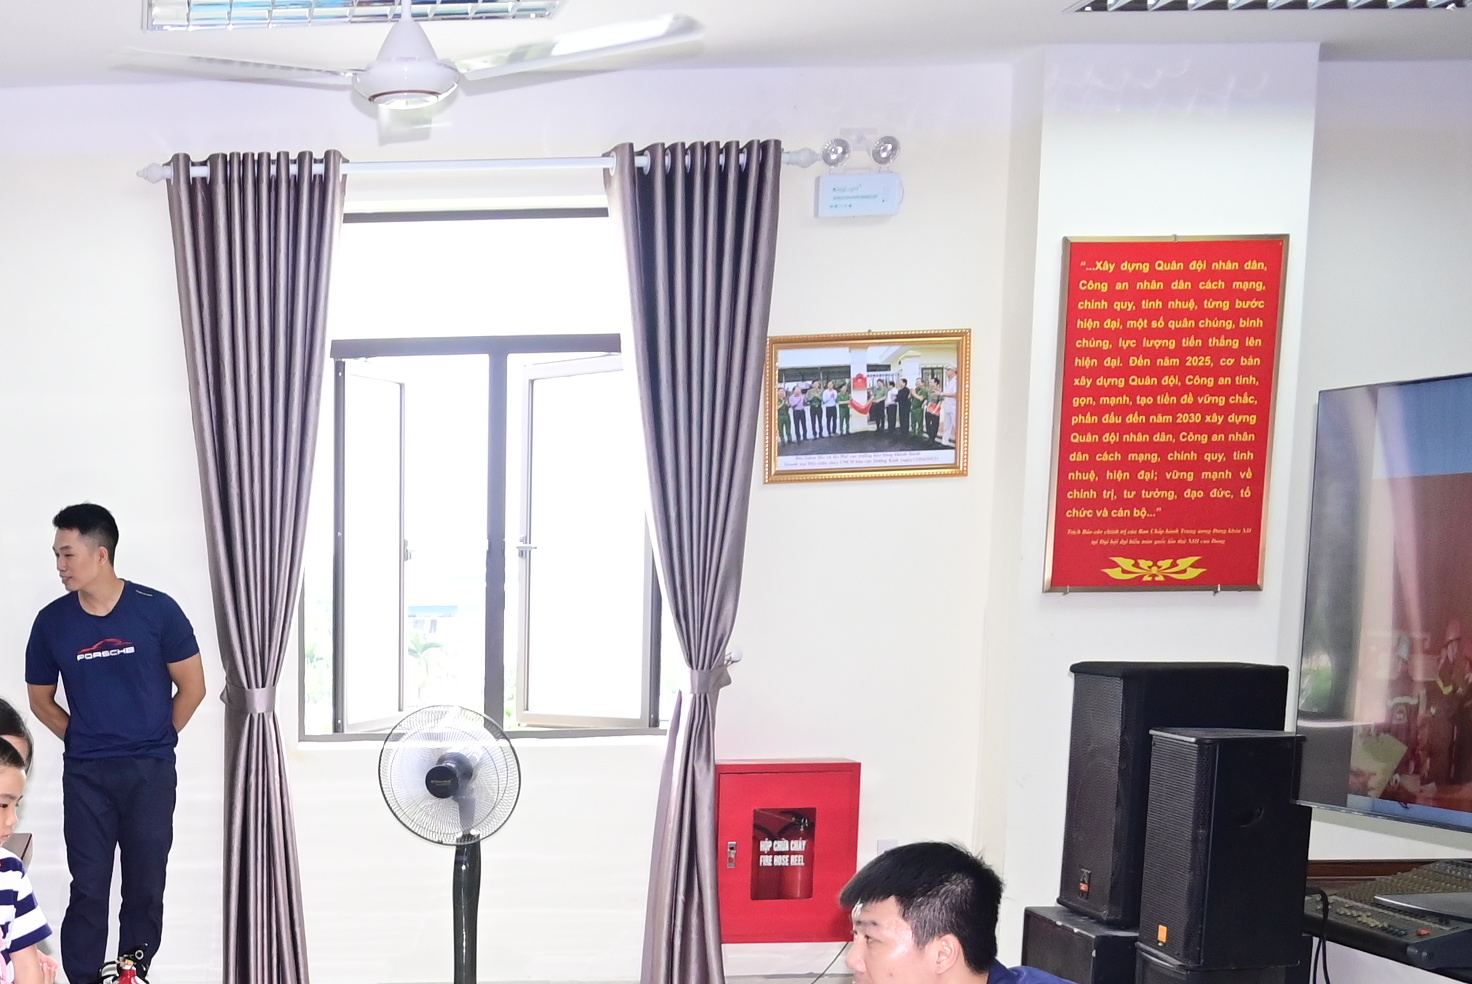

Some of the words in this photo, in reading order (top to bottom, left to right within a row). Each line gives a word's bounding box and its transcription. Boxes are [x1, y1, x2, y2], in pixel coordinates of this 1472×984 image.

[1120, 260, 1150, 273] dựng
[1154, 260, 1185, 271] Quân
[1188, 259, 1207, 273] đội
[1211, 259, 1239, 271] nhân
[1078, 279, 1109, 293] Công
[1115, 281, 1129, 291] an
[1136, 279, 1164, 290] nhân
[1170, 279, 1192, 290] dân
[1198, 279, 1225, 290] cách
[1077, 298, 1108, 310] chính
[1141, 298, 1163, 309] tinh
[1203, 298, 1230, 312] từng
[1235, 298, 1265, 309] bước
[1076, 318, 1100, 331] hiện
[1126, 318, 1148, 331] một
[1151, 316, 1165, 329] số
[1167, 317, 1196, 330] quân
[1239, 317, 1264, 328] binh
[1118, 337, 1137, 350] lực
[1142, 337, 1176, 350] lượng
[1245, 336, 1262, 347] lên
[1074, 356, 1098, 369] hiện
[1128, 354, 1151, 367] Đến
[1156, 356, 1180, 367] năm
[1219, 357, 1236, 366] cơ
[1073, 375, 1093, 388] xây
[1095, 375, 1126, 388] dựng
[1128, 375, 1158, 386] Quân
[1185, 374, 1215, 388] Công
[1217, 376, 1232, 385] an
[1136, 394, 1154, 407] tạo
[1156, 392, 1177, 405] tiền
[1180, 392, 1194, 405] đề
[1197, 393, 1226, 407] vững
[1071, 411, 1099, 426] phấn
[1125, 411, 1146, 424] đến
[1149, 413, 1173, 424] năm
[1176, 412, 1202, 424] 2030
[1204, 412, 1225, 425] xây
[1227, 412, 1257, 425] dựng
[1070, 432, 1099, 443] Quân
[1102, 432, 1120, 445] đội
[1122, 431, 1150, 443] nhân
[1179, 431, 1209, 444] Công
[1211, 433, 1225, 442] an
[1228, 431, 1256, 442] nhân
[1068, 451, 1090, 462] dân
[1095, 450, 1122, 462] cách
[1167, 450, 1198, 461] chính
[1233, 450, 1254, 461] tinh
[1106, 469, 1130, 482] hiện
[1165, 469, 1195, 482] vững
[1201, 469, 1233, 482] mạnh
[1239, 467, 1253, 480] về
[1066, 488, 1097, 499] chính
[1123, 489, 1137, 499] tư
[1183, 488, 1204, 500] đạo
[1065, 507, 1094, 518] chức
[1095, 507, 1109, 518] và
[1110, 507, 1131, 518] cán
[77, 646, 135, 662] PORSCHE
[790, 836, 807, 852] CHÁY
[759, 854, 773, 867] FIRE
[773, 854, 790, 867] HOSE
[790, 854, 806, 867] REEL
